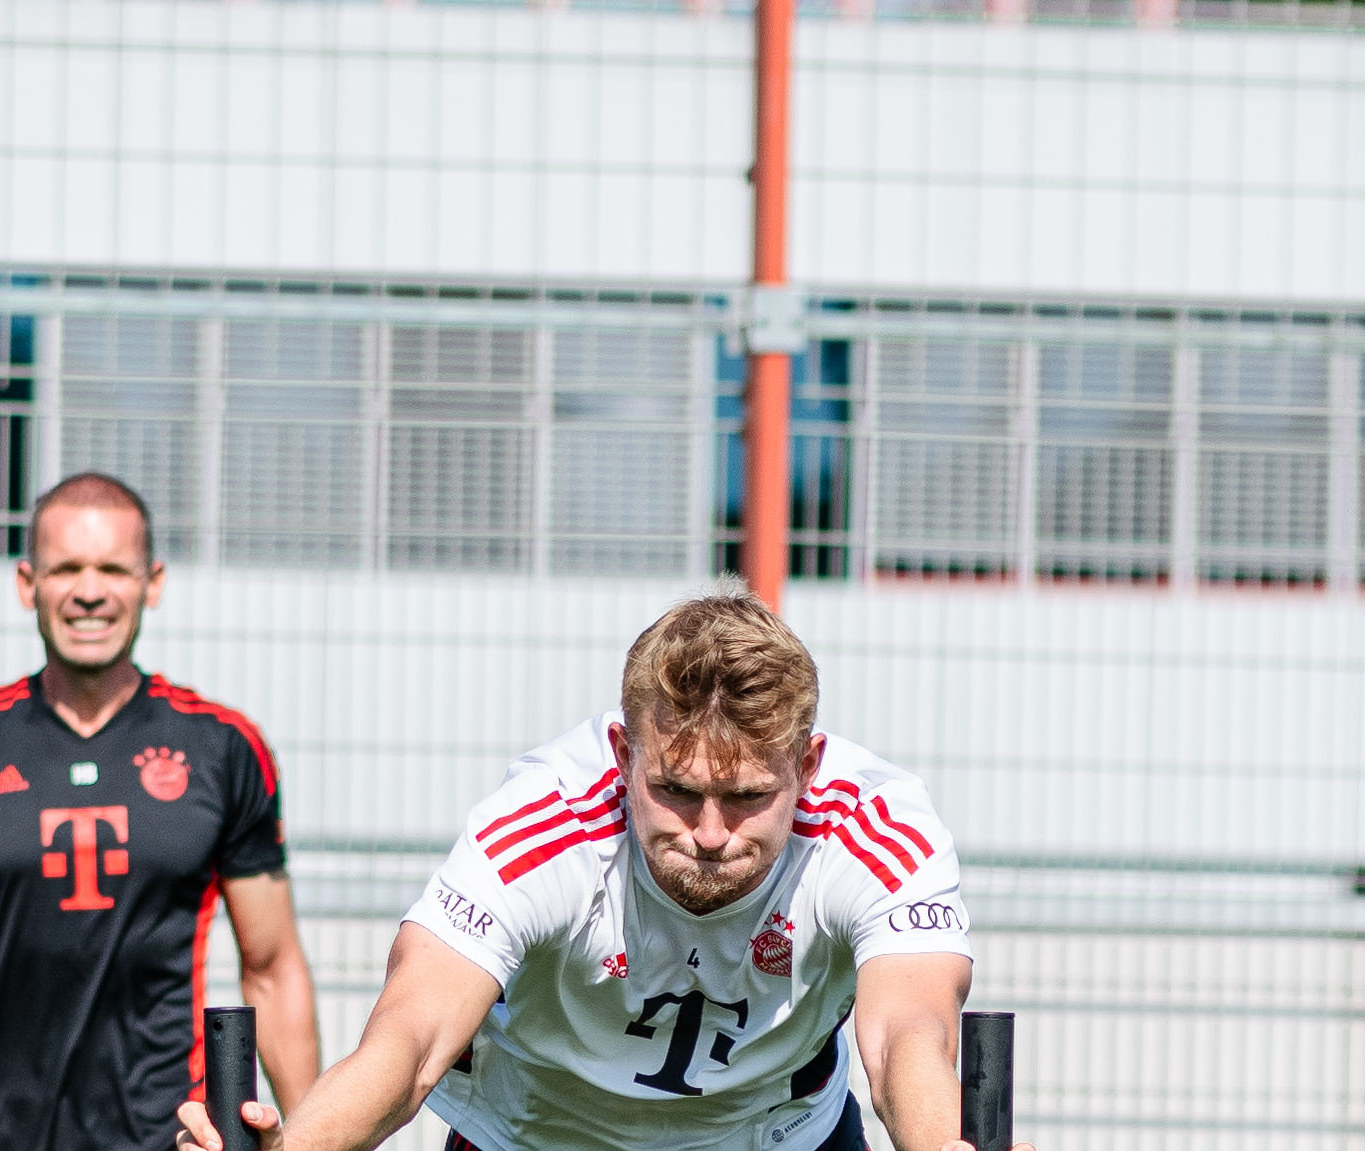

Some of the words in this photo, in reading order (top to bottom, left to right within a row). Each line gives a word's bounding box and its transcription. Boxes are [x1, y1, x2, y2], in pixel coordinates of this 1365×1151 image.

[40, 804, 129, 912] T
[687, 947, 700, 969] 4
[624, 989, 749, 1096] T
